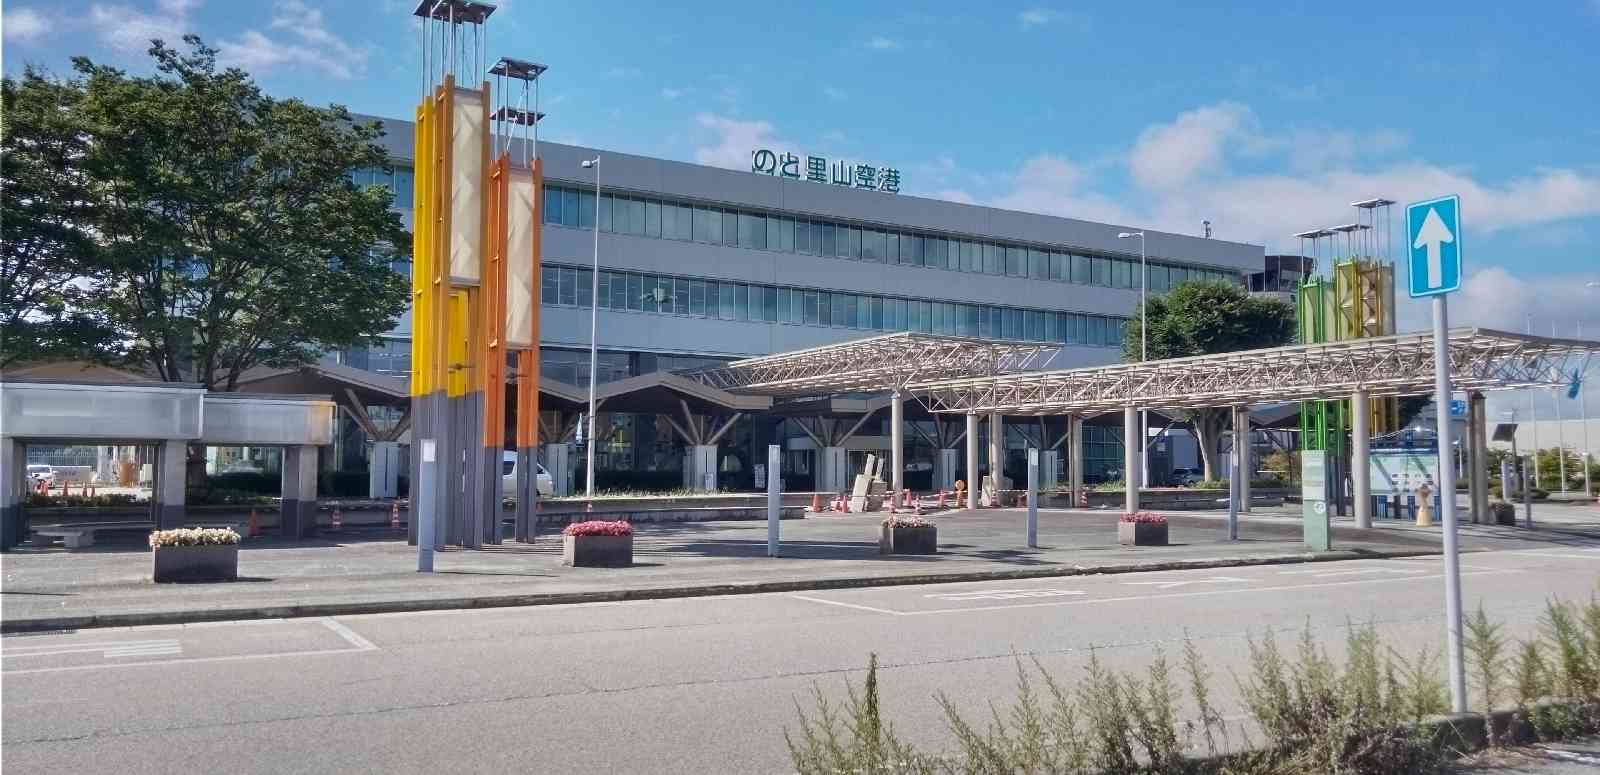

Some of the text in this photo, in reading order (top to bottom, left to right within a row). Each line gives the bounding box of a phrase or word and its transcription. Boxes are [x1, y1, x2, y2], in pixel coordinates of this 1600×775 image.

[752, 149, 900, 193] のと里山空港
